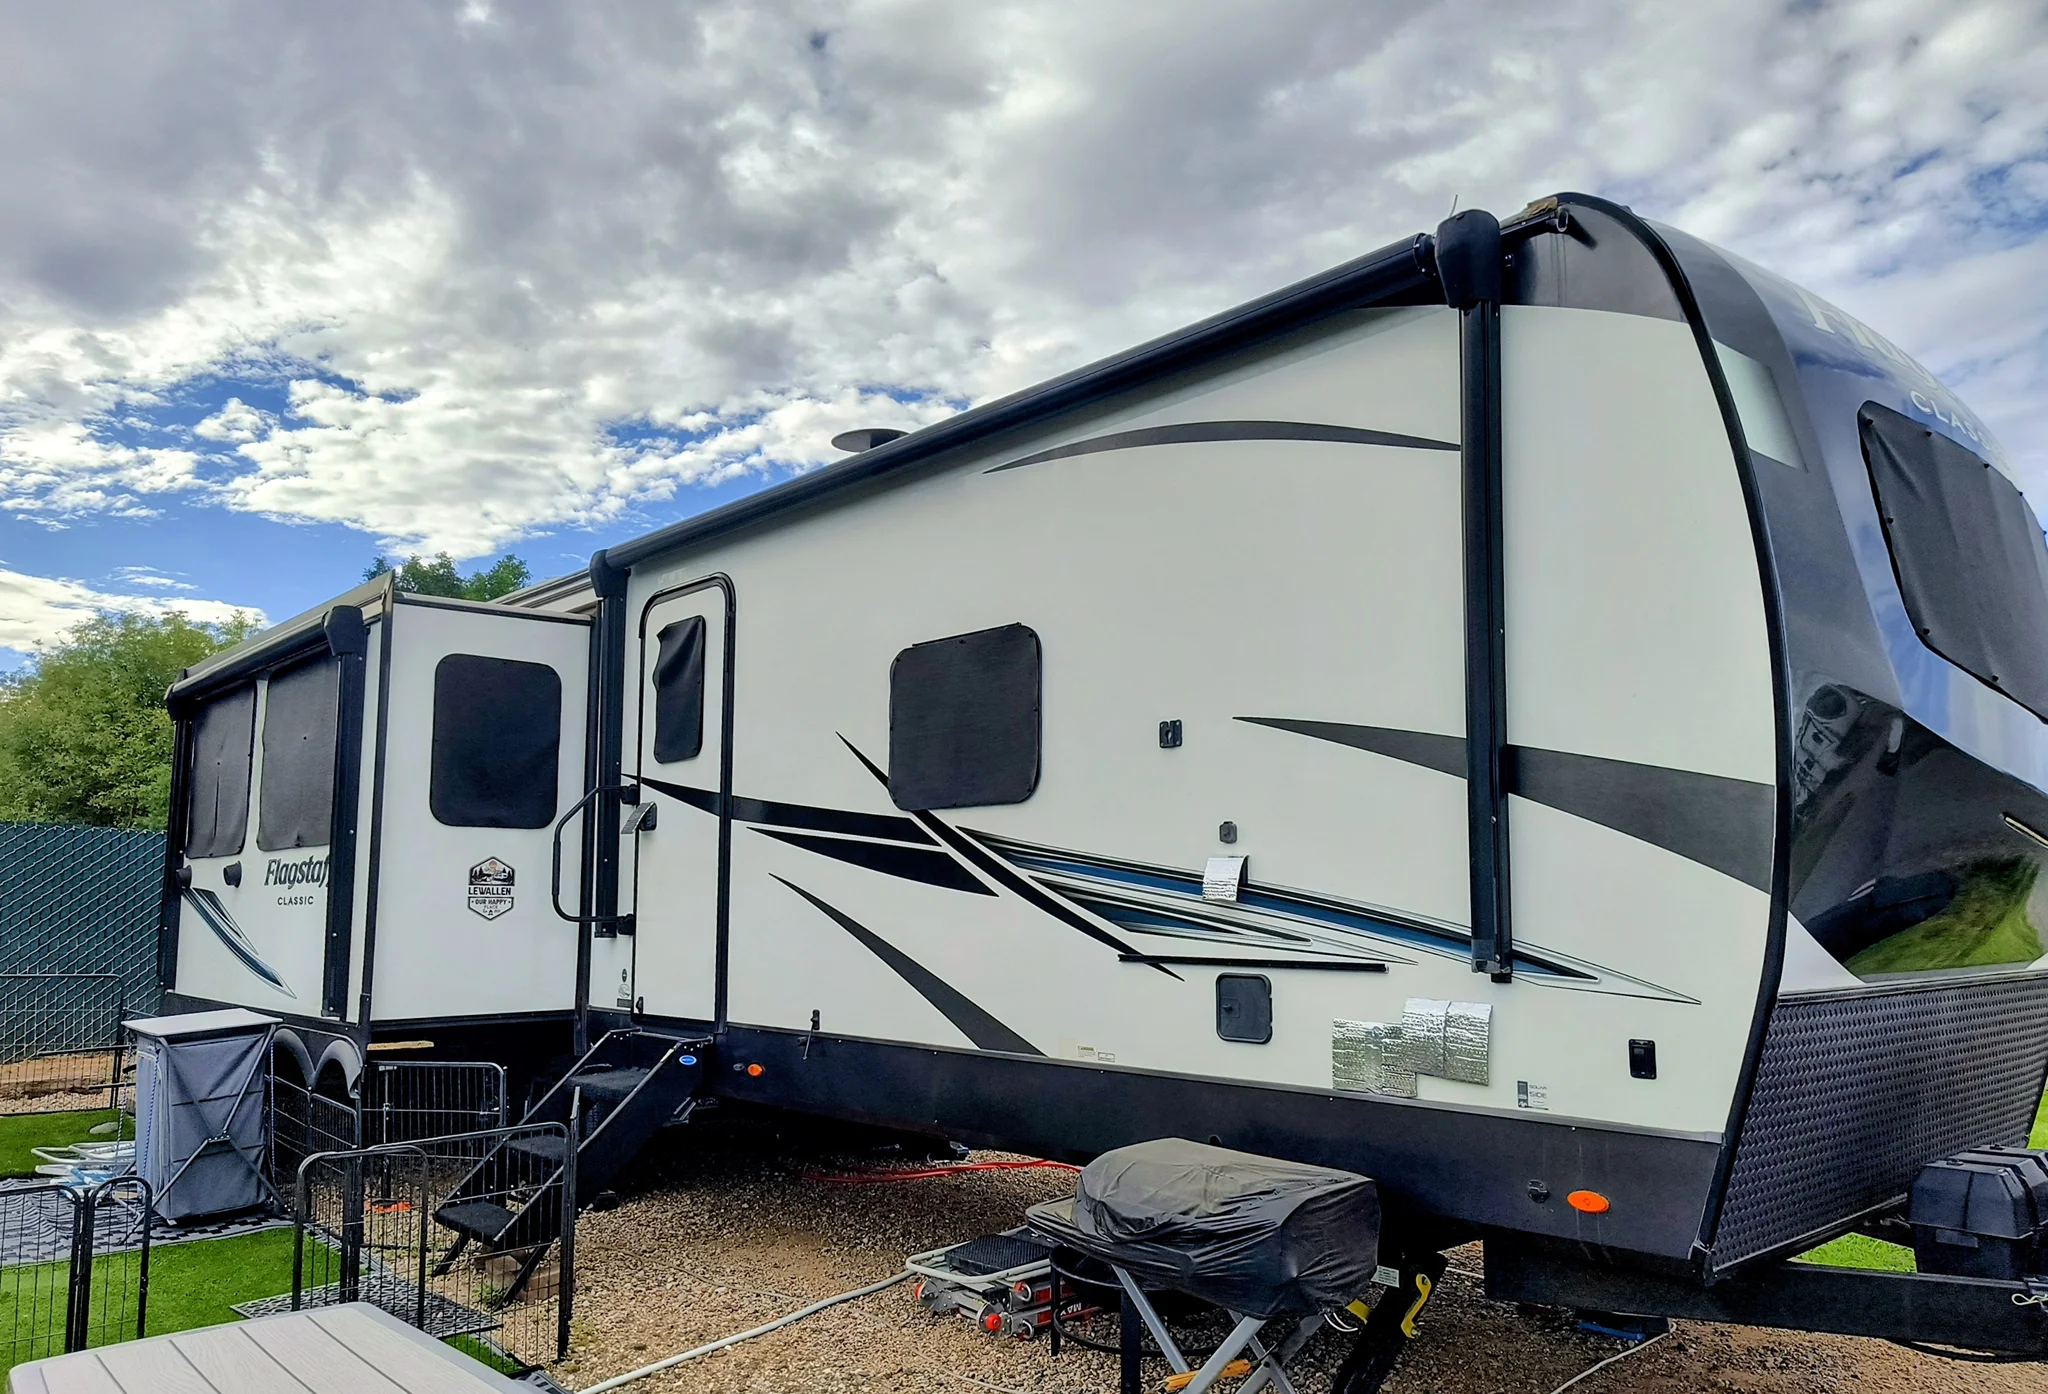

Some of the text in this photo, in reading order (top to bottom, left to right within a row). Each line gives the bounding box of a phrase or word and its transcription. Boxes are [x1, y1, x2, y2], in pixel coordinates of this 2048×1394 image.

[264, 855, 330, 890] Flagstaf
[468, 887, 511, 896] LEWALLEN
[277, 896, 314, 906] CLASSIC
